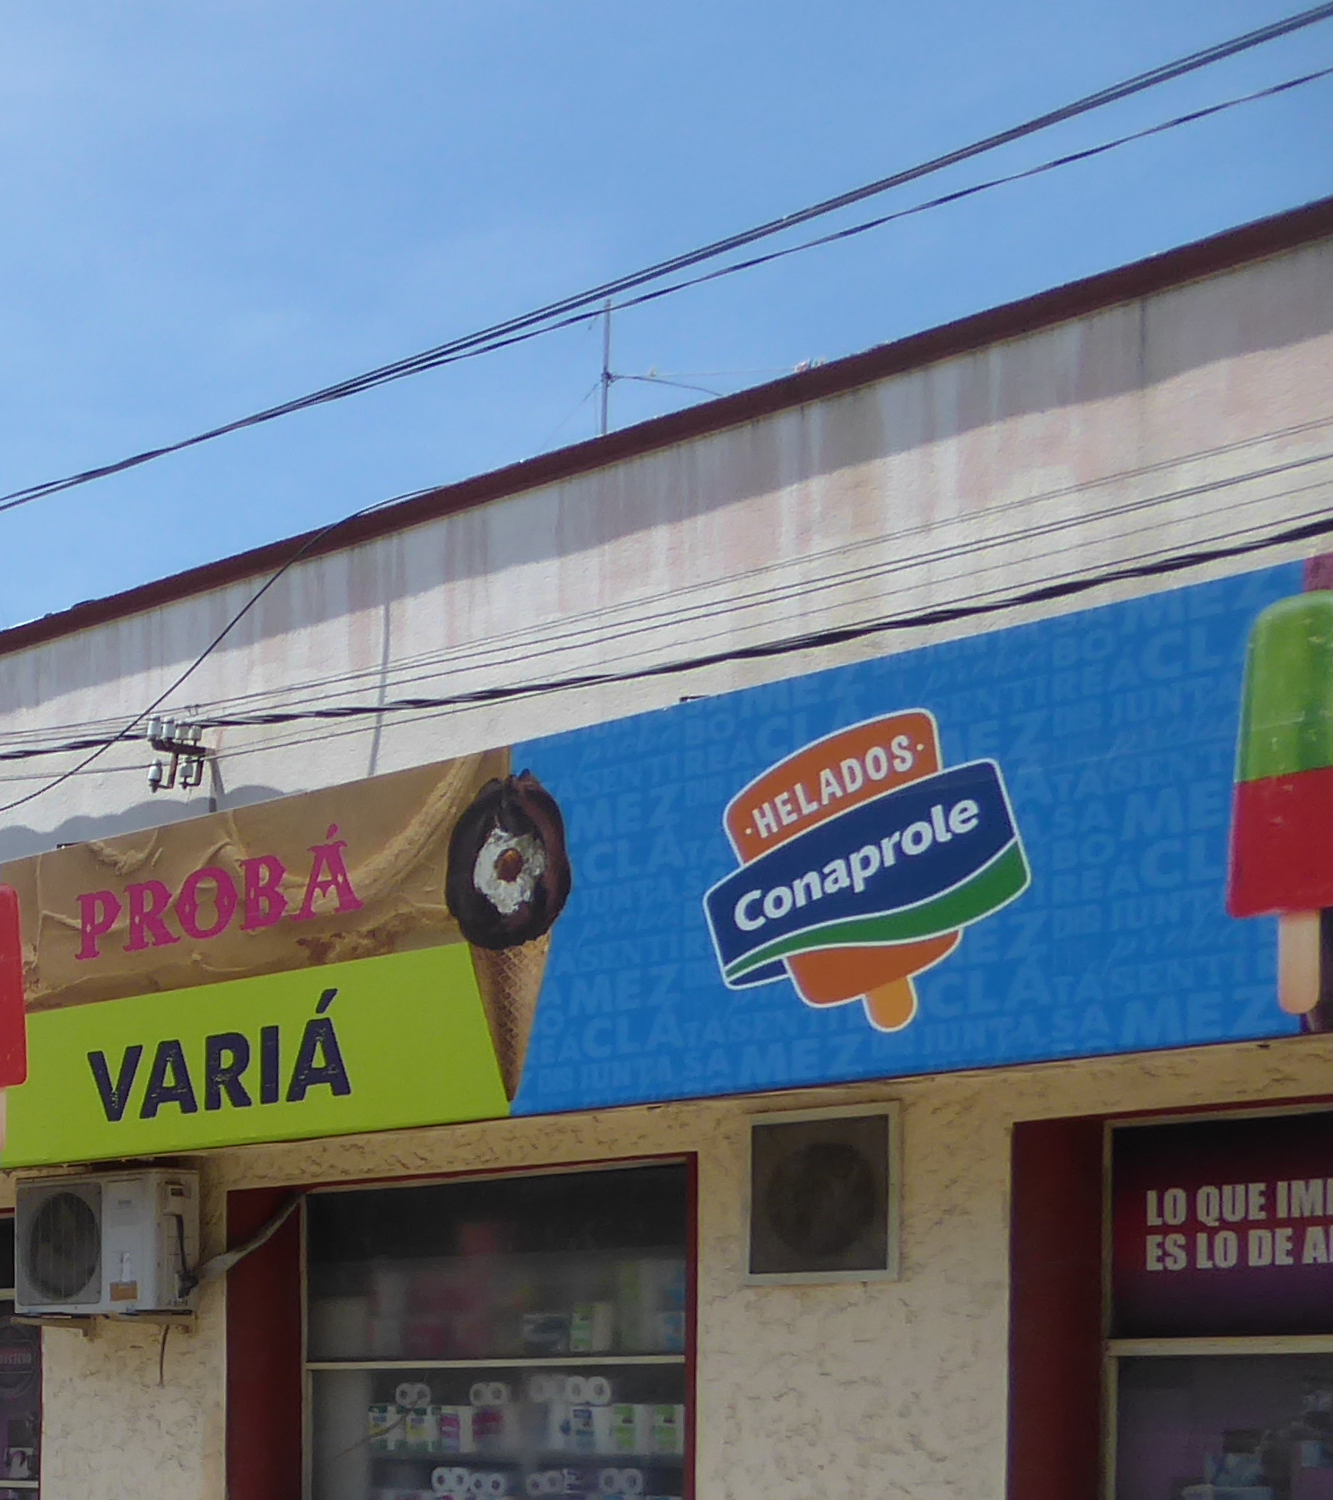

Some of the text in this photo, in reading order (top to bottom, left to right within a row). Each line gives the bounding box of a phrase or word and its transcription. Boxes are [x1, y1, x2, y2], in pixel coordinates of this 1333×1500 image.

[752, 733, 916, 840] HELADOS
[75, 824, 364, 960] PROBÁ
[733, 797, 981, 932] Conaprole
[88, 988, 352, 1123] VARIÁ
[1145, 1225, 1333, 1272] ES LO DE A
[1146, 1187, 1187, 1226] LO
[1196, 1182, 1267, 1227] QUE
